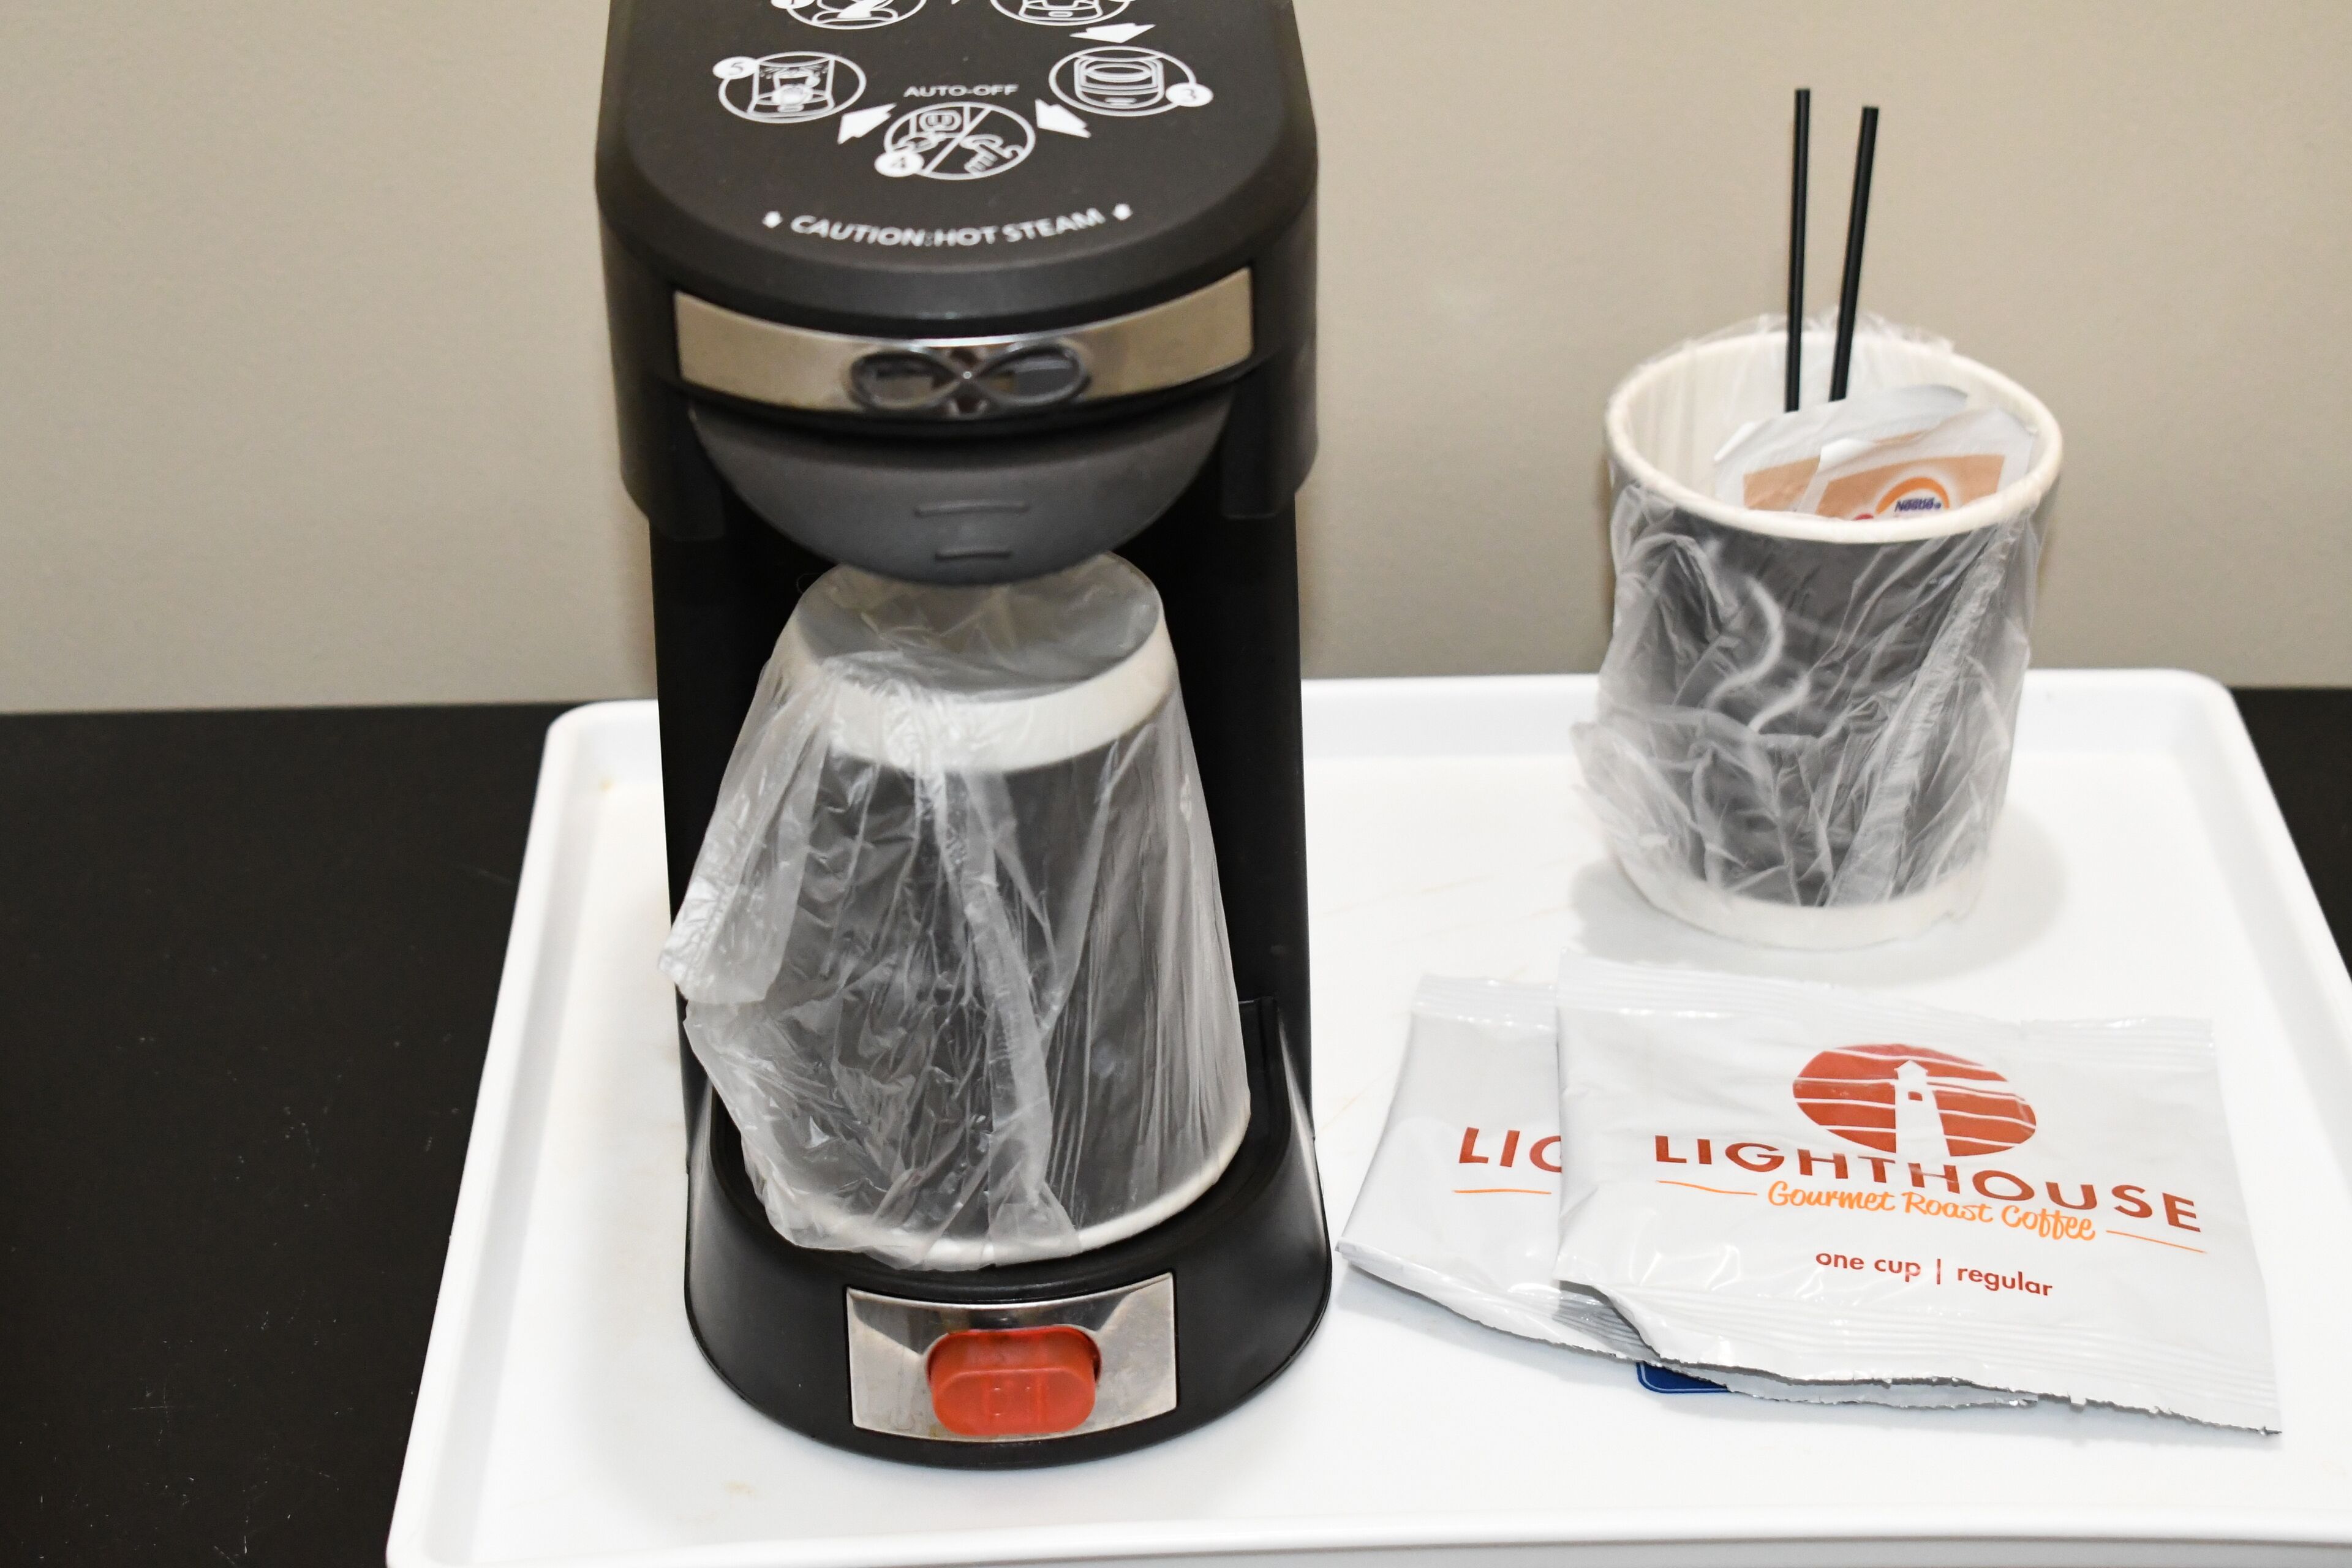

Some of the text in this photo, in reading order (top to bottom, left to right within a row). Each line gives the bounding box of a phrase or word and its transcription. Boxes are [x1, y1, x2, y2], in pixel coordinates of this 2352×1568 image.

[903, 84, 1019, 97] AUTO-OFF
[934, 227, 999, 247] HOT
[1002, 207, 1106, 243] STEAM
[1655, 1135, 2201, 1232] LIGHTHOUSE
[1768, 1180, 2097, 1241] Gourmet Roast Coffee
[1815, 1253, 1864, 1270] one
[1874, 1258, 1921, 1283] cup
[1957, 1267, 2053, 1296] regular
